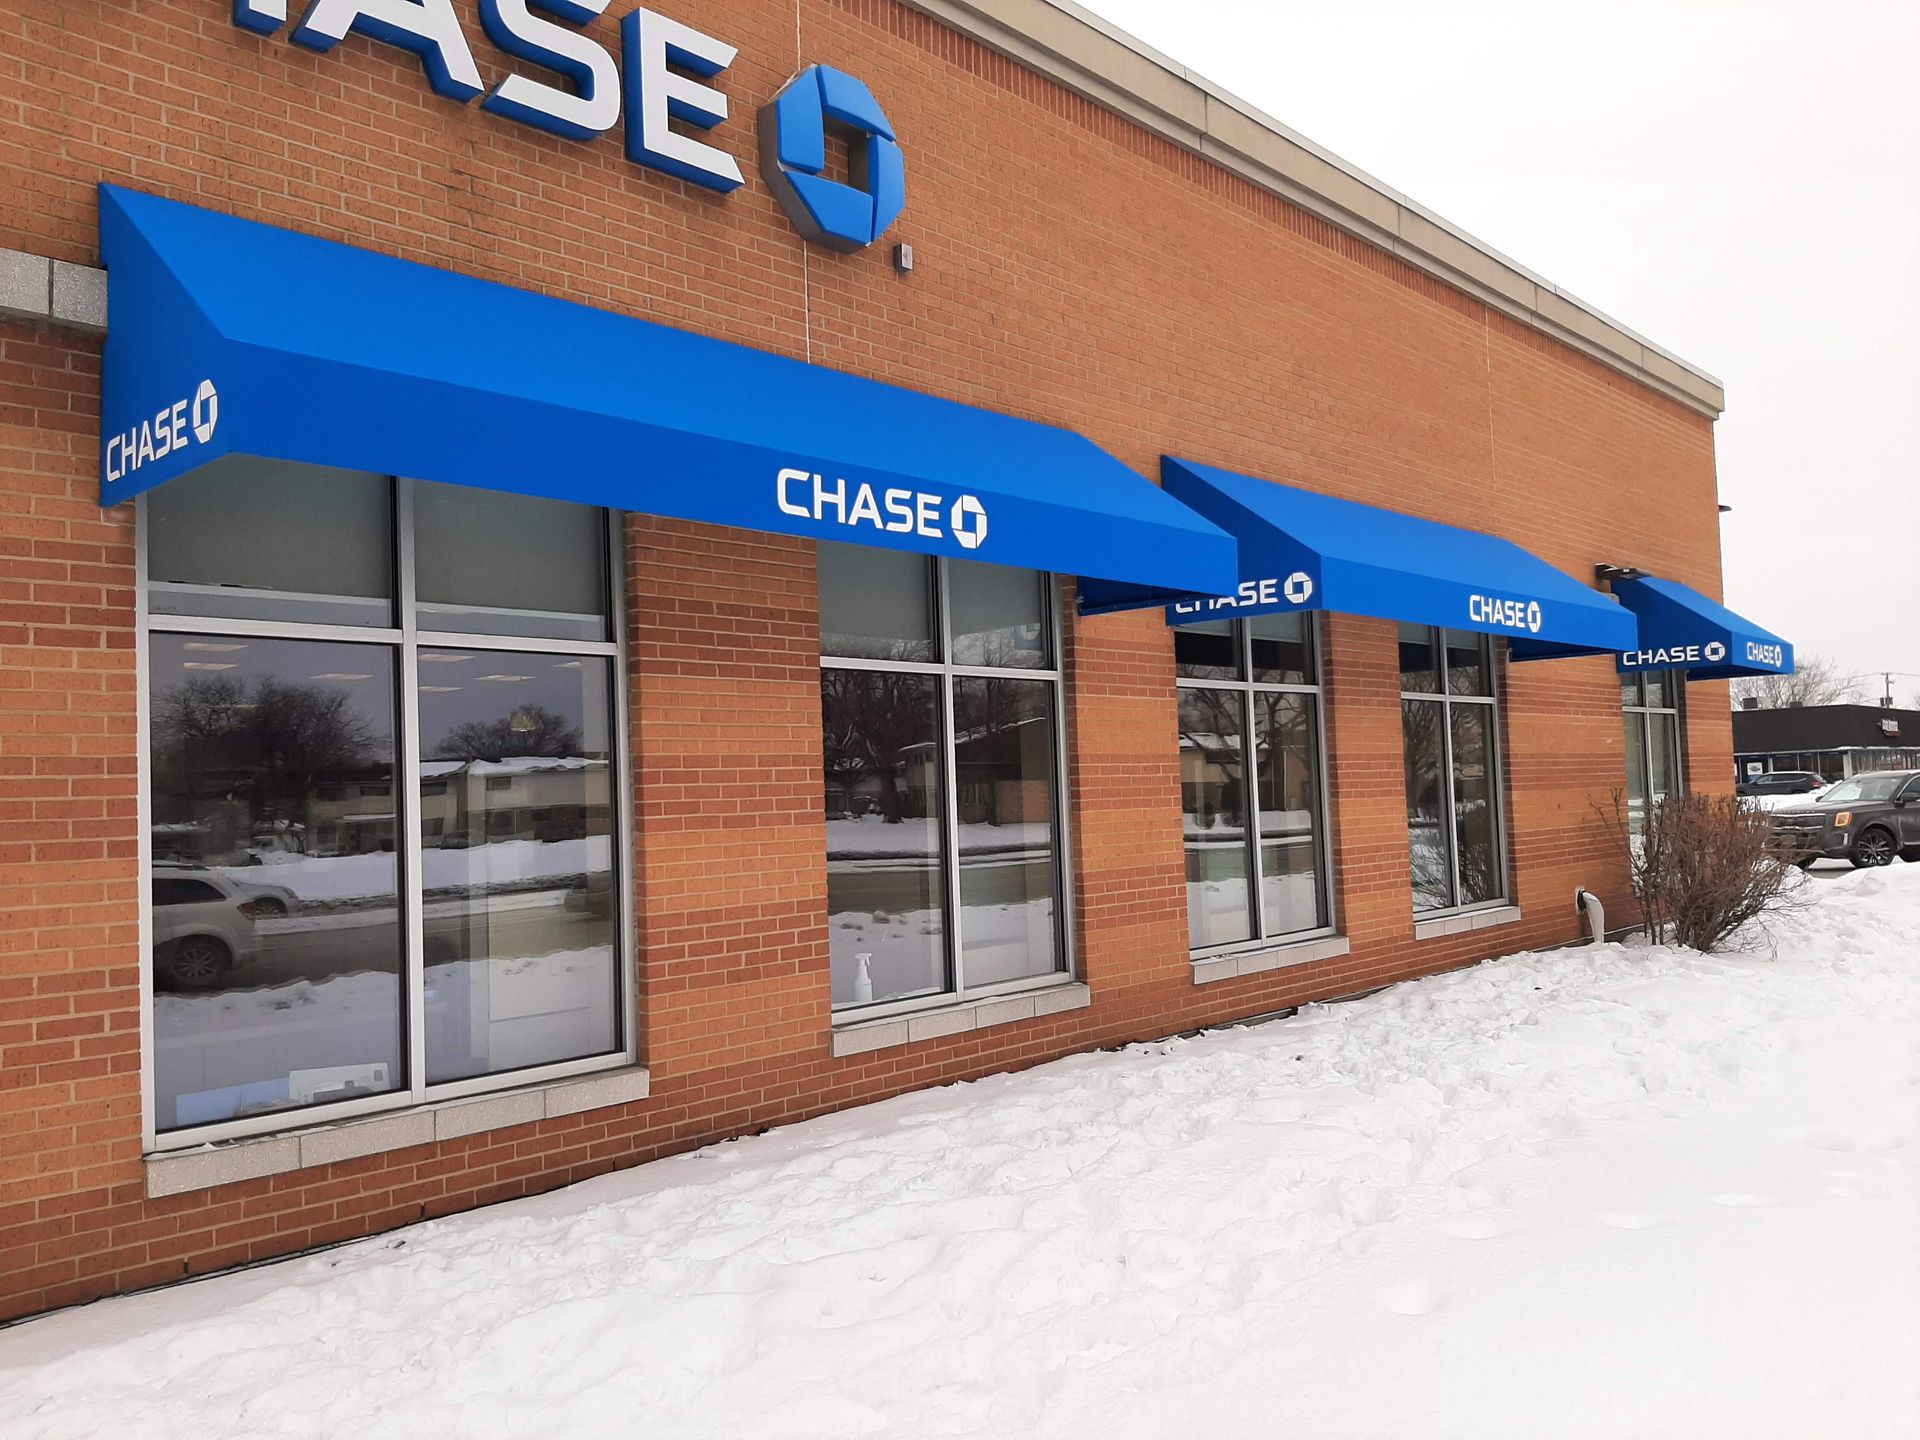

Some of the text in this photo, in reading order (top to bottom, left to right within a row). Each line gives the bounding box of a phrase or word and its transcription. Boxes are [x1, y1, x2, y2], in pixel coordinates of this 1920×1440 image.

[106, 399, 189, 482] CHASE
[777, 468, 943, 538] CHASE
[1469, 594, 1526, 628] CHASE
[1622, 645, 1701, 666] CHASE
[1746, 641, 1775, 664] CHASE
